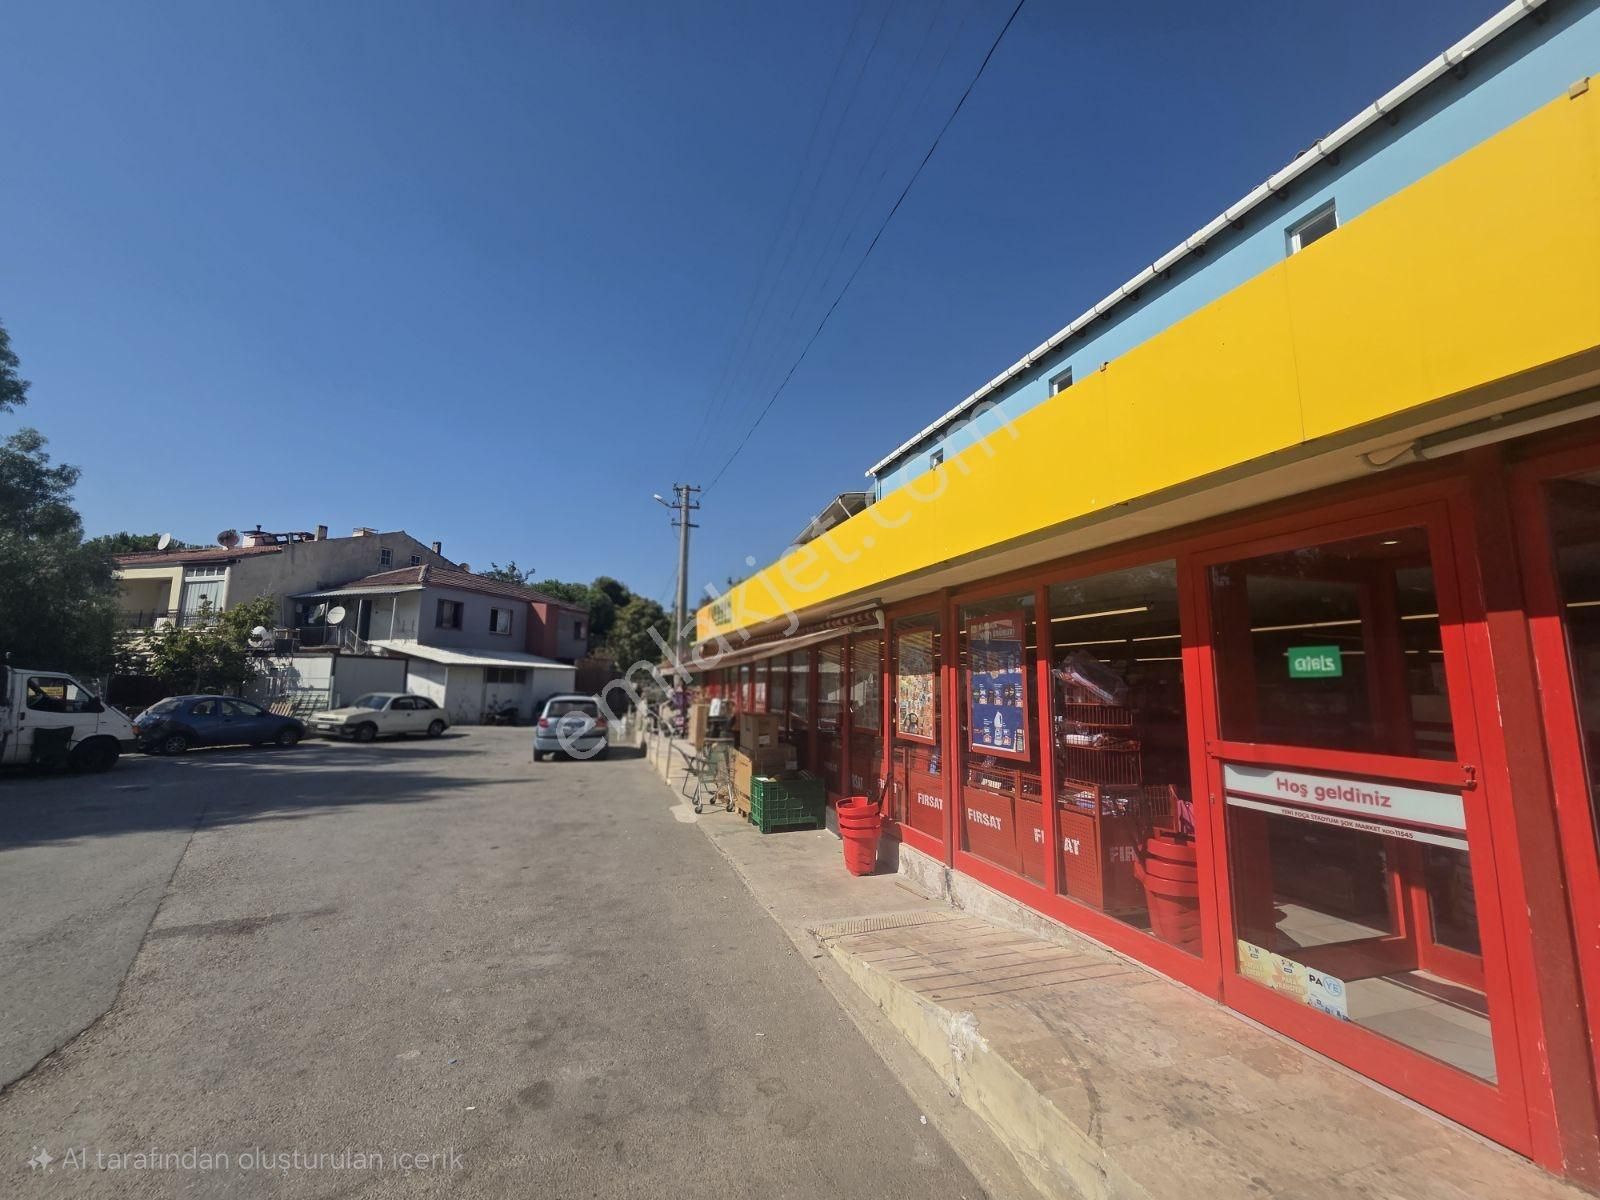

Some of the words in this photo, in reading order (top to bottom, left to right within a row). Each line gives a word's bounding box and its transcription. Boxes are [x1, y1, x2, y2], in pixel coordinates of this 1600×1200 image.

[917, 792, 943, 810] FIRSAT
[1276, 777, 1308, 797] Hoş
[1315, 785, 1392, 808] geldiniz
[967, 807, 1002, 831] FIRSAT
[1355, 823, 1381, 832] MARKET
